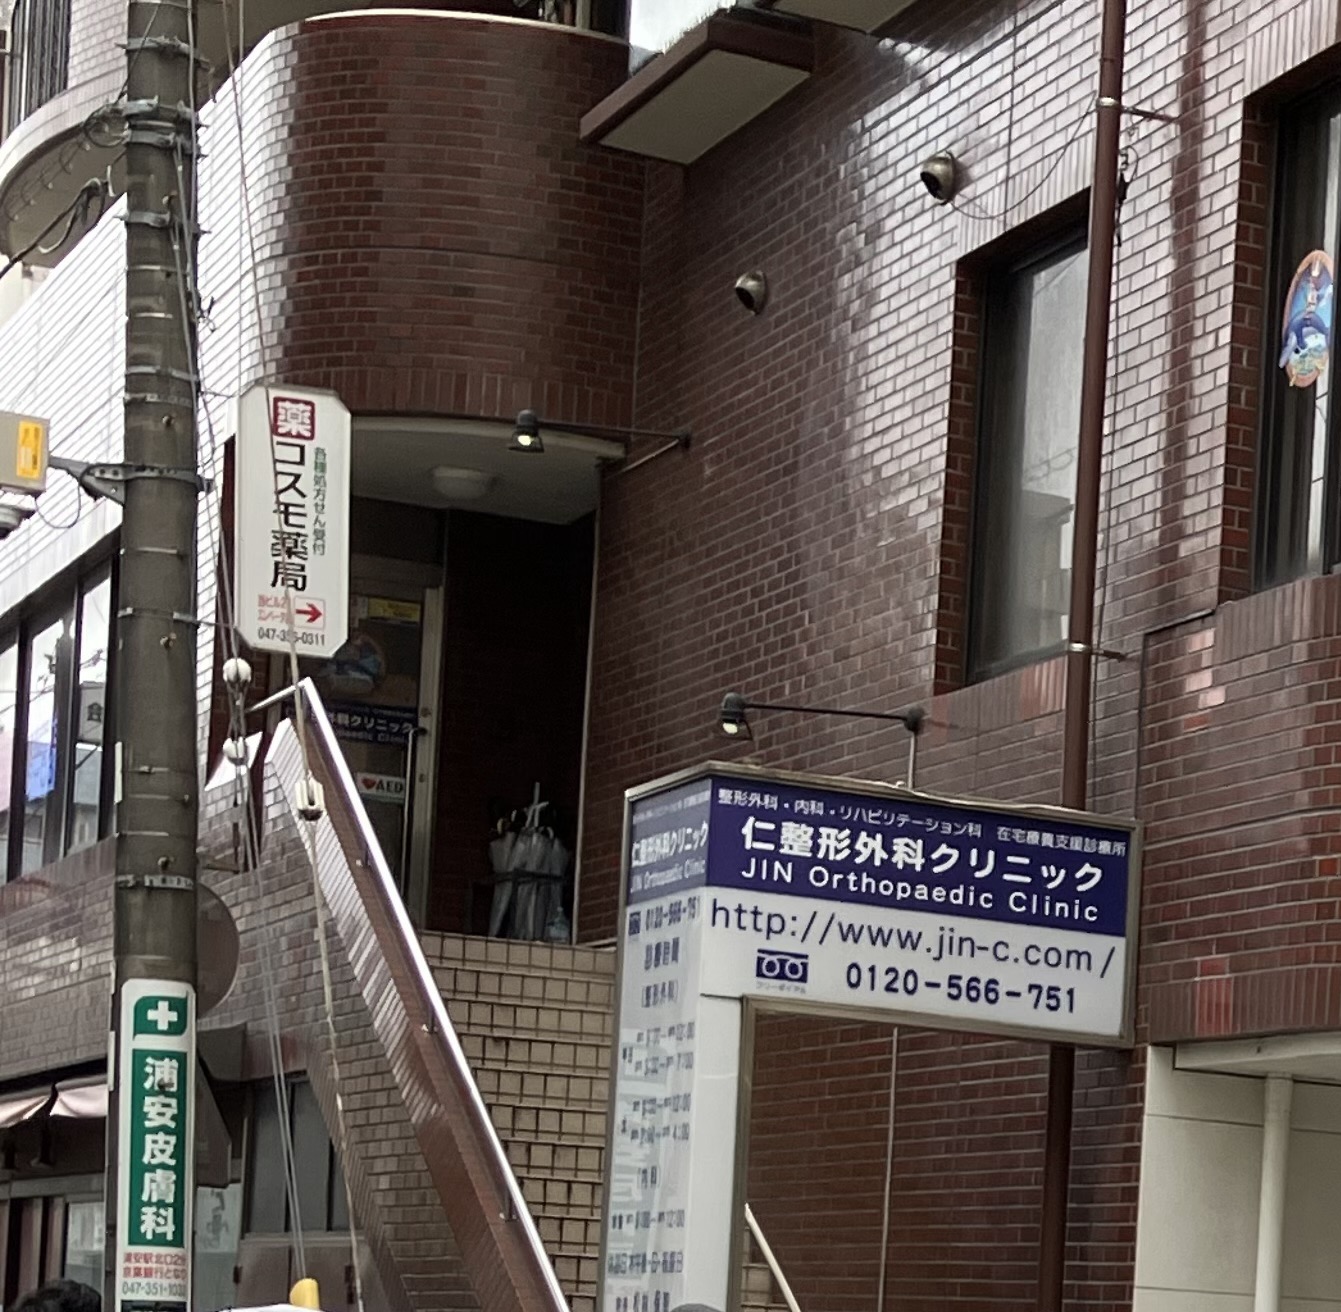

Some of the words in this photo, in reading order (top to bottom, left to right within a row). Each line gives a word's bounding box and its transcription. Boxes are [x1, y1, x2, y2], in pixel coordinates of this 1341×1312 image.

[276, 399, 312, 437] 薬
[269, 440, 308, 592] コスモ薬局
[257, 626, 325, 645] 047-3-0311
[375, 780, 403, 793] AED
[741, 816, 1103, 893] 仁整形外科クリニック
[741, 857, 793, 883] JIN
[808, 865, 994, 910] Orthopaedic
[1008, 890, 1099, 922] Clinic
[846, 961, 1076, 1014] 0120-566-751
[140, 1056, 179, 1241] 浦安皮膚科
